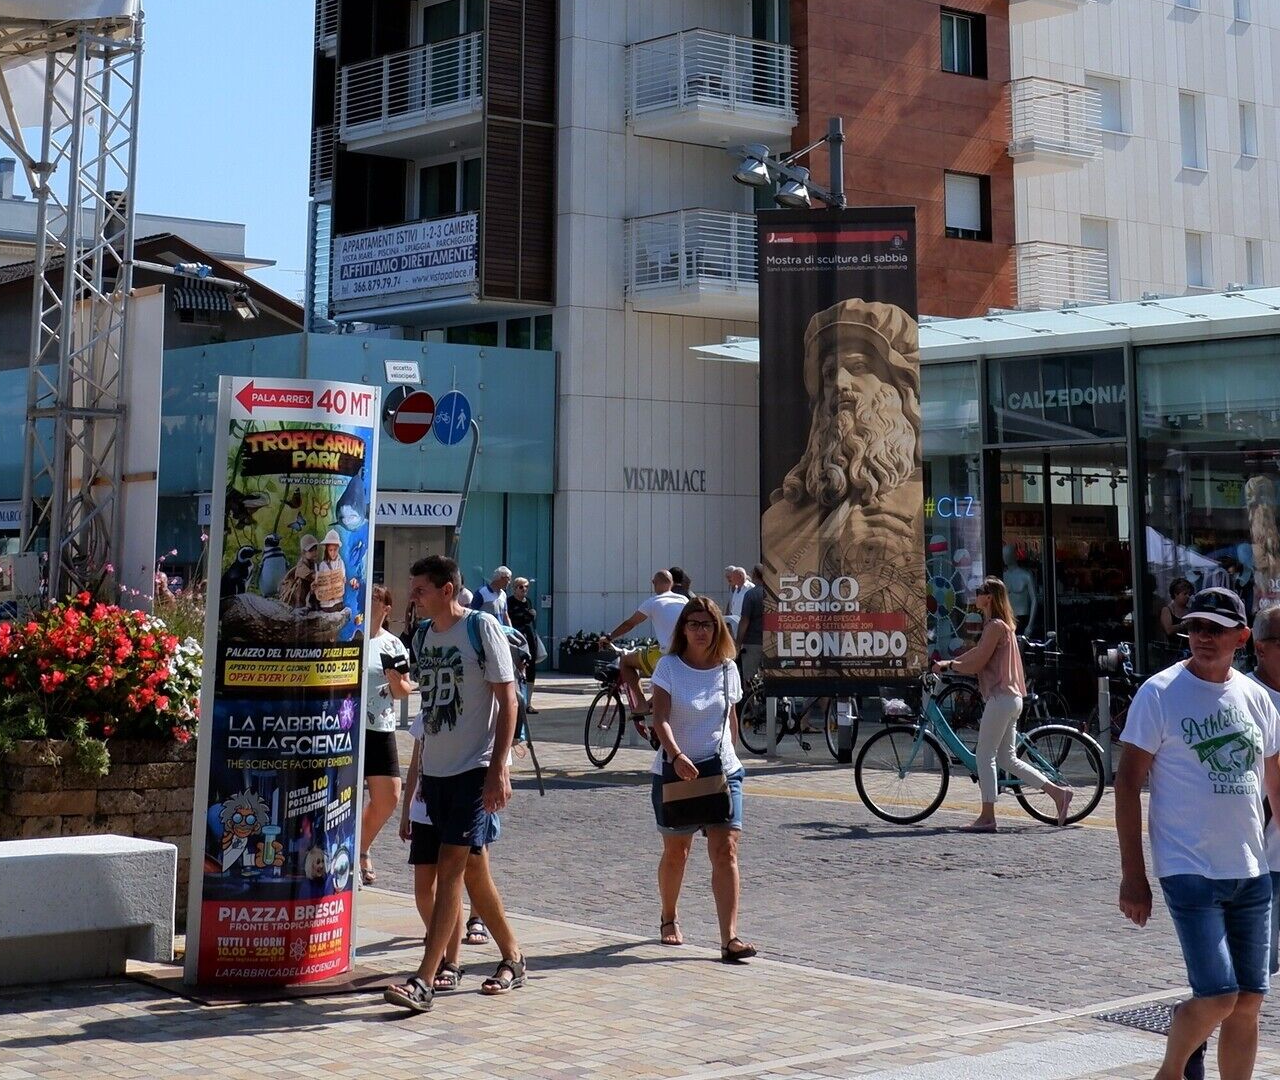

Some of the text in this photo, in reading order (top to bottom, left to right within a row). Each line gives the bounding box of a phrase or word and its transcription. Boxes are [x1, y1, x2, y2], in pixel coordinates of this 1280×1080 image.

[342, 219, 475, 254] APPARTAMENTI ESTIVI 1-2-3 CAMERE
[342, 254, 358, 262] VISTA
[358, 251, 373, 260] MARE
[377, 247, 400, 258] PISCINA
[404, 242, 431, 253] SPIAGGIA
[435, 234, 475, 248] PARCHEGGIO
[342, 247, 474, 280] AFFITTIAMO DIRETTAMENTE
[766, 253, 908, 265] Mostra di sculture di sabbia
[412, 266, 474, 285] www.vistapalace.it
[252, 389, 371, 416] PALA ARREX 40 MT
[1008, 385, 1128, 410] CALZEDONIA
[246, 432, 365, 459] TROPICARIUM
[292, 450, 341, 470] PARK
[623, 467, 707, 493] VISTAPALACE
[376, 503, 453, 517] AN MARCO
[925, 495, 975, 518] #CLZ
[778, 576, 860, 601] 500
[778, 601, 860, 612] IL GENIO DI
[782, 622, 810, 630] GIUGNO
[822, 622, 859, 630] SETTEMBRE
[809, 614, 833, 622] PIAZZA
[833, 614, 861, 622] BRESCIA
[225, 647, 265, 658] PALAZZO
[267, 648, 282, 658] DEL
[285, 648, 322, 658] TURISMO
[322, 648, 342, 658] PIAZZA
[777, 631, 908, 657] LEONARDO
[228, 663, 256, 671] APERTO
[315, 663, 336, 673] 10.00
[228, 673, 258, 682] OPEN
[260, 673, 288, 683] EVERY
[290, 674, 309, 684] DAY
[229, 716, 256, 731] LA
[1181, 705, 1247, 744] Athletic
[228, 732, 353, 755] DELLA SCIENZA
[227, 759, 245, 769] THE
[246, 759, 288, 770] SCIENCE
[290, 758, 327, 770] FACTORY
[288, 775, 329, 799] OLTRE 100
[340, 786, 352, 804] 100
[288, 788, 328, 808] POSTAZIONI
[219, 898, 345, 922] PIAZZA BRESCIA
[229, 915, 340, 931] FRONTE TROPICARIUM PARK
[217, 936, 287, 947] TUTTI I GIORNI
[309, 931, 331, 945] EVERY
[217, 947, 247, 957] 10.00
[255, 946, 286, 957] 22.00
[215, 958, 342, 978] LAFABBRICADELLASCIENZA.IT
